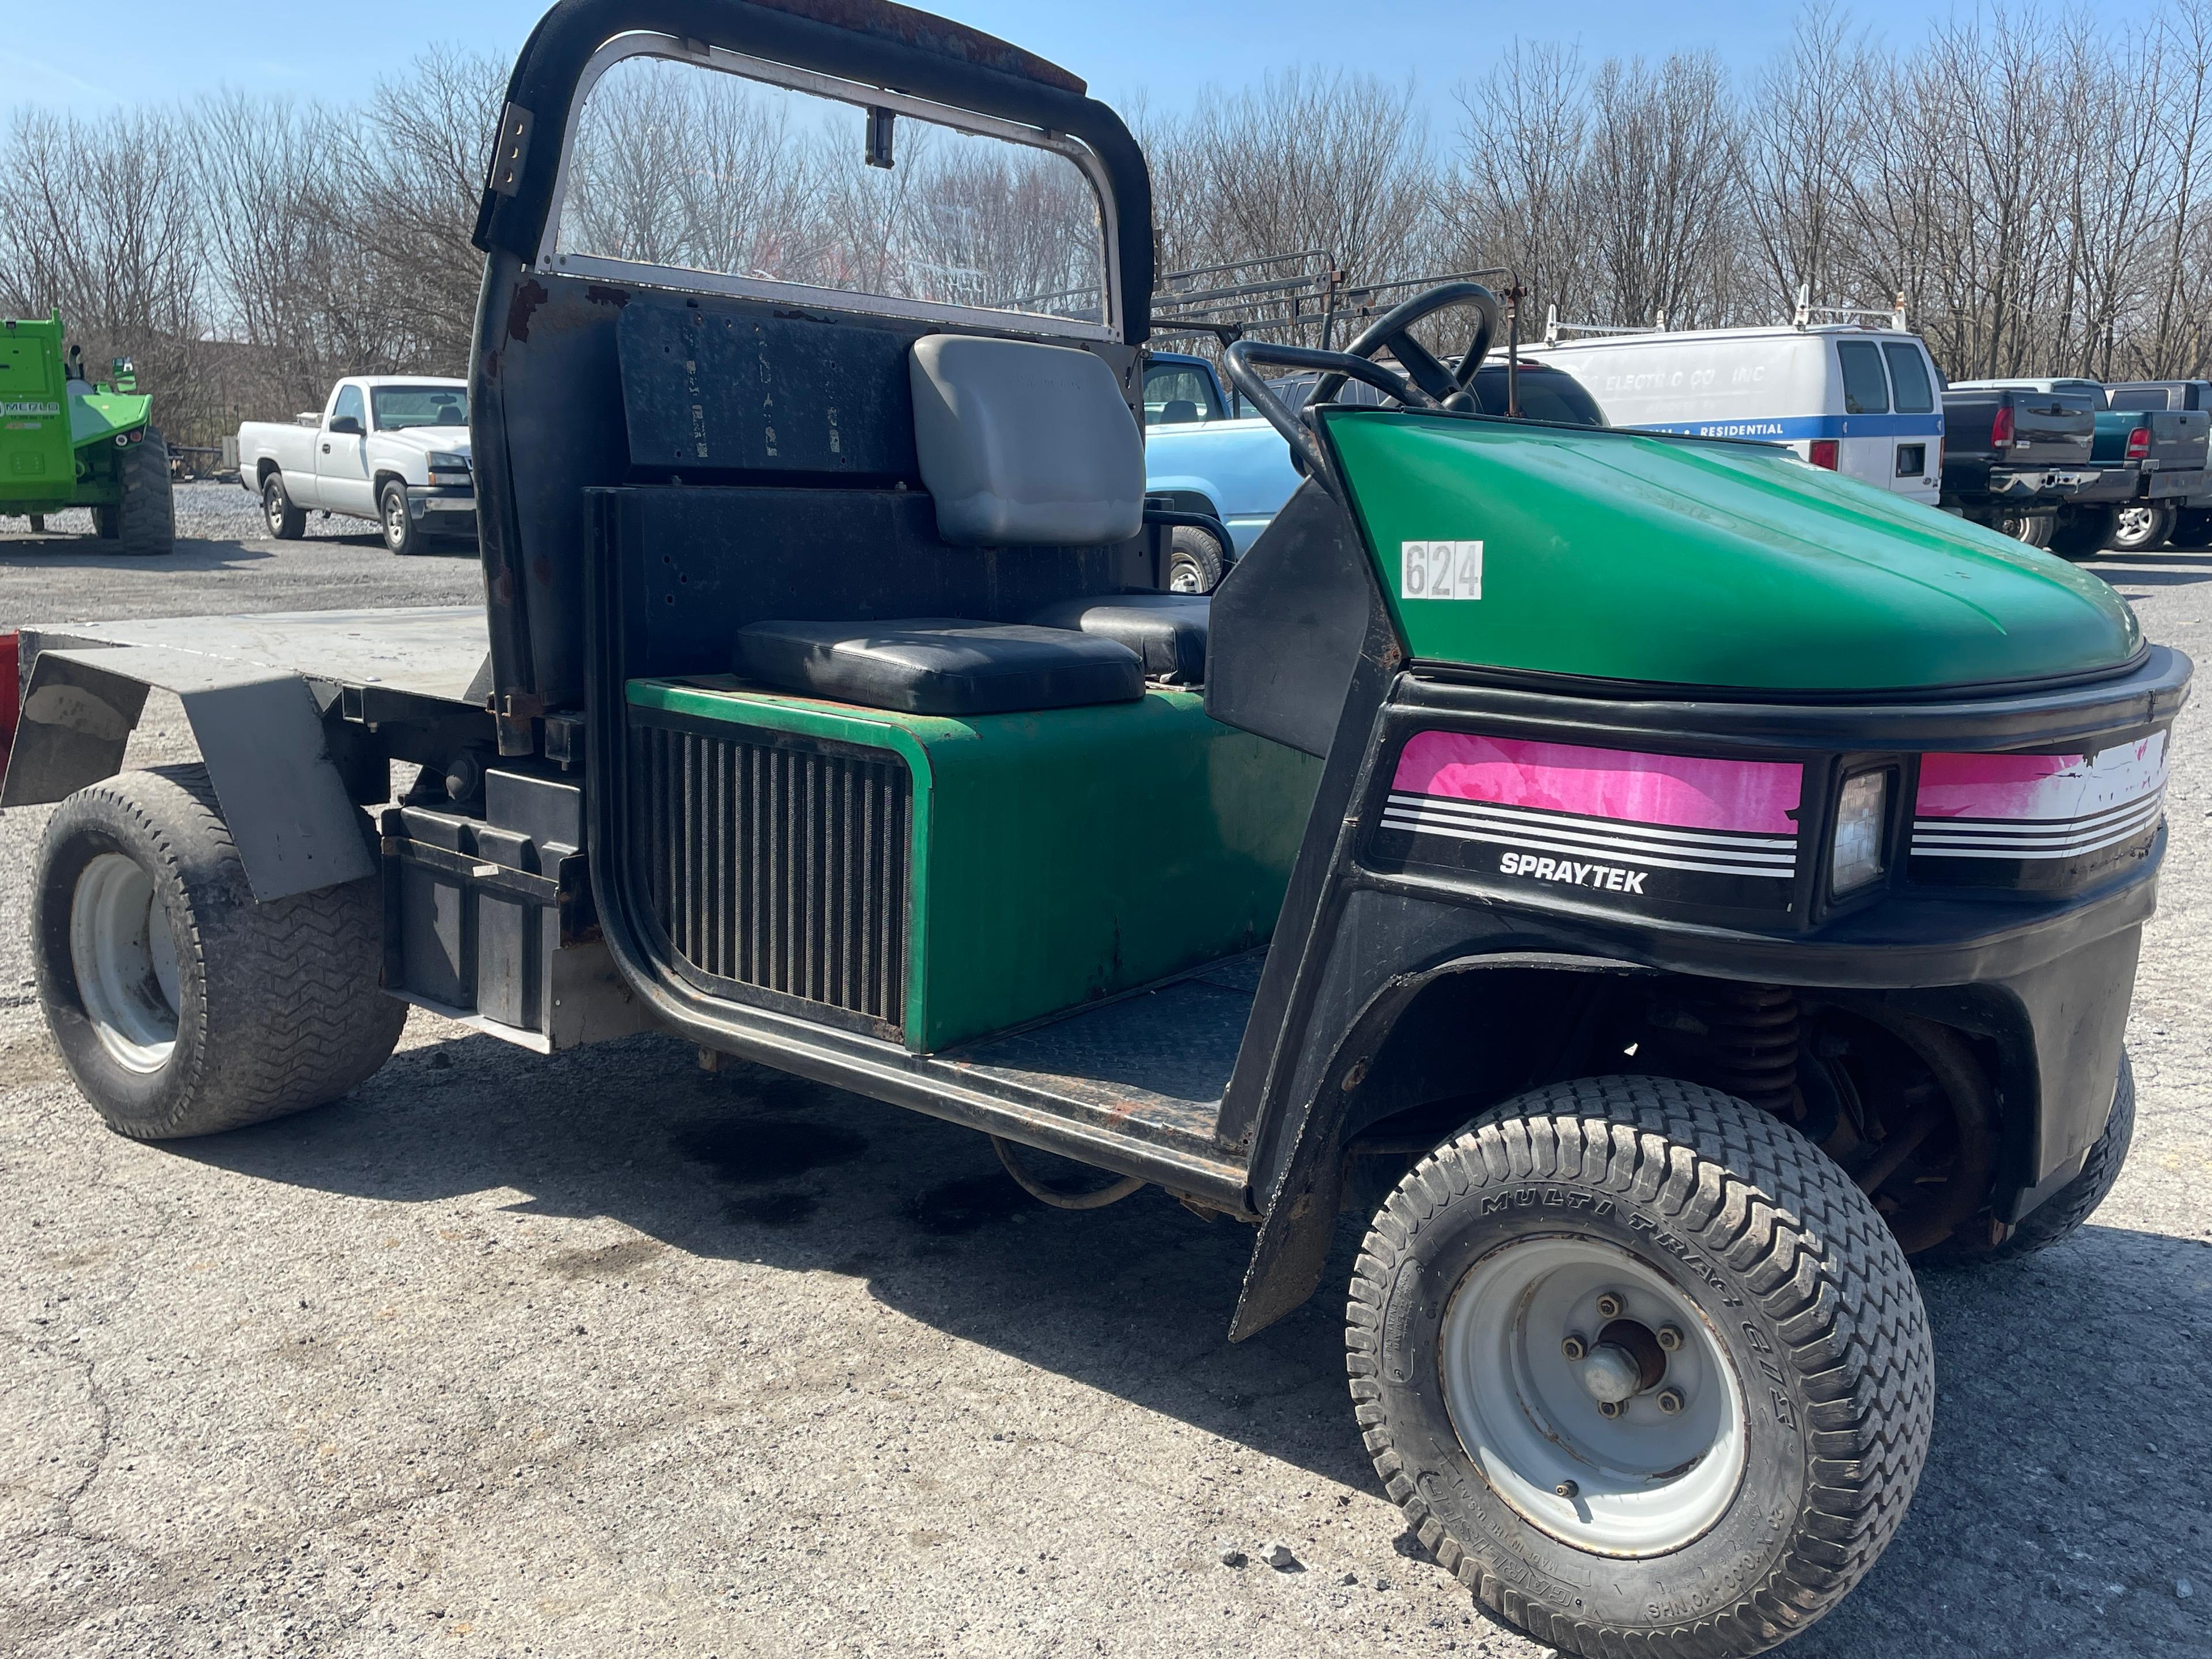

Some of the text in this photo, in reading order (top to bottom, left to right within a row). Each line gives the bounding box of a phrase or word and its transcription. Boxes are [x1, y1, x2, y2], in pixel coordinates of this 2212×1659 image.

[1700, 424, 1783, 437] RESIDENTIAL
[1406, 544, 1479, 596] 624
[1499, 852, 1648, 894] SPRAYTEK
[1481, 1188, 1614, 1215] MULTI
[1628, 1212, 1744, 1308] TRAC
[1389, 1303, 1398, 1335] RATING
[1487, 1520, 1510, 1543] THE
[1766, 1504, 1785, 1531] 20
[1424, 1475, 1574, 1607] CARLISLE
[1511, 1539, 1527, 1554] IN
[1527, 1552, 1558, 1571] MADE
[1724, 1548, 1763, 1589] 10.00
[1646, 1597, 1688, 1619] NHS
